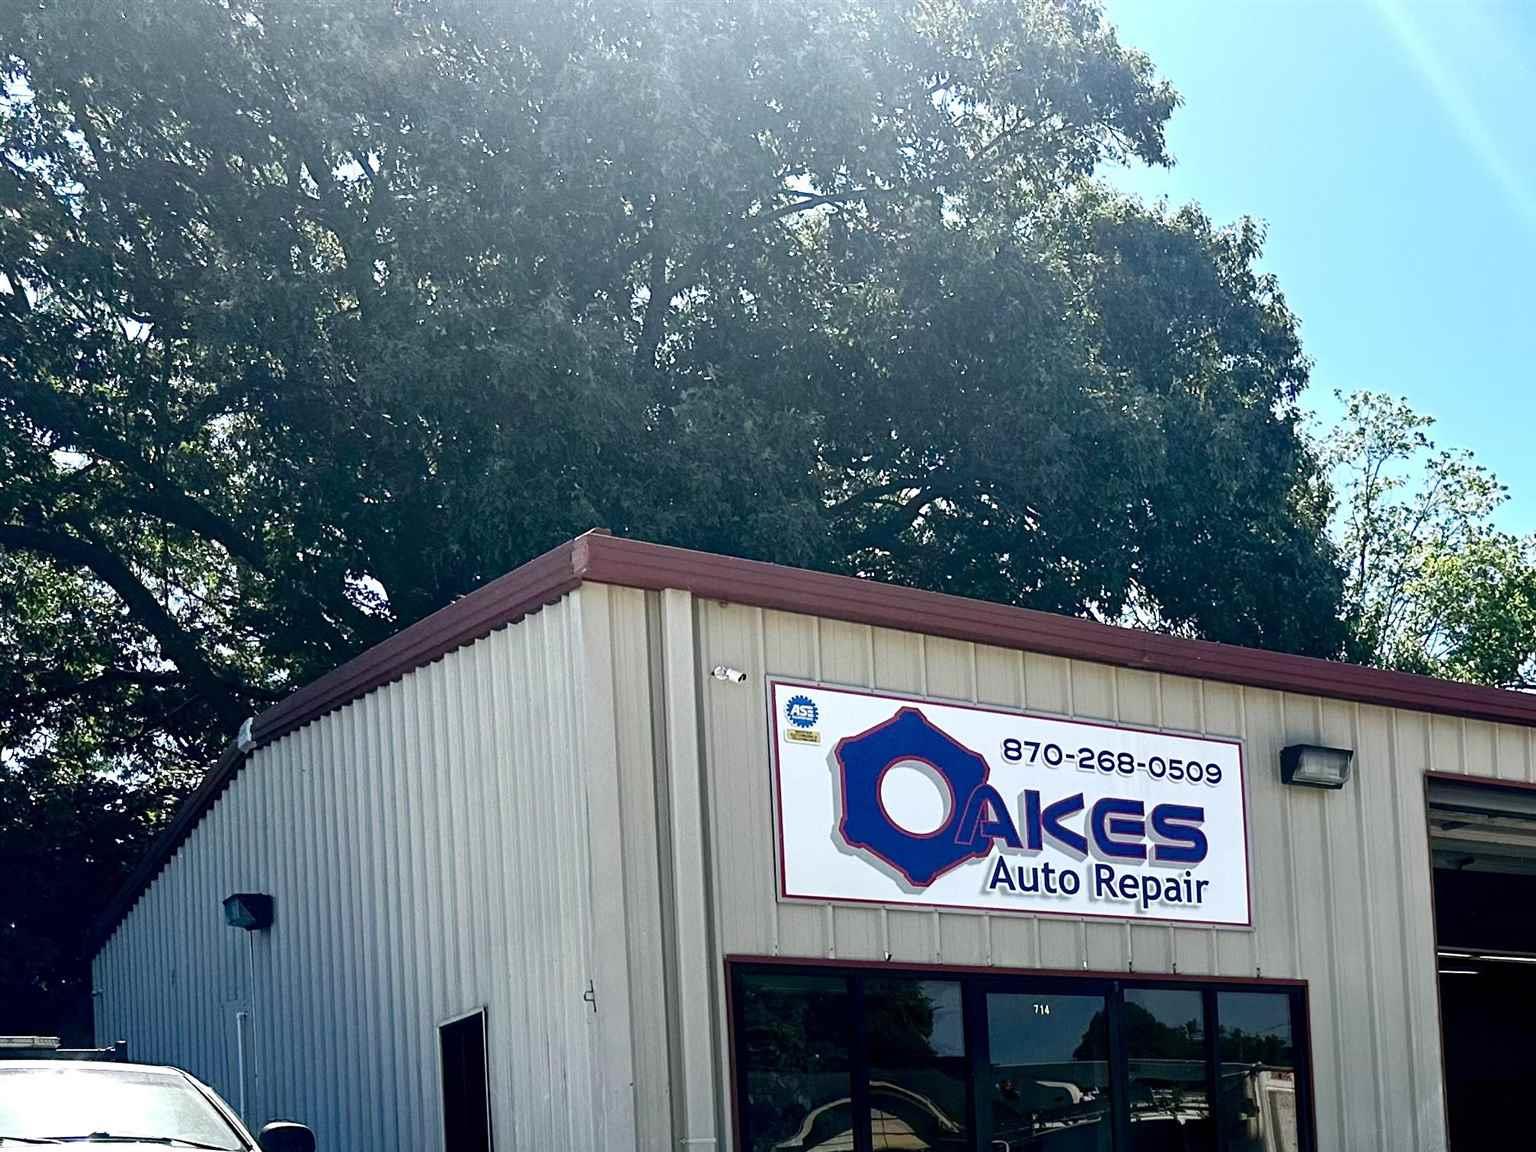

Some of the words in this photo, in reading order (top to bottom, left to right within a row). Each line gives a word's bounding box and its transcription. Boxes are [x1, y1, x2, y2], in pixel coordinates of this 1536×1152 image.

[790, 703, 814, 718] ASE
[1003, 738, 1222, 784] 870-268-0509
[989, 855, 1080, 894] Auto
[1094, 863, 1209, 909] Repair
[1033, 1004, 1050, 1015] 714
